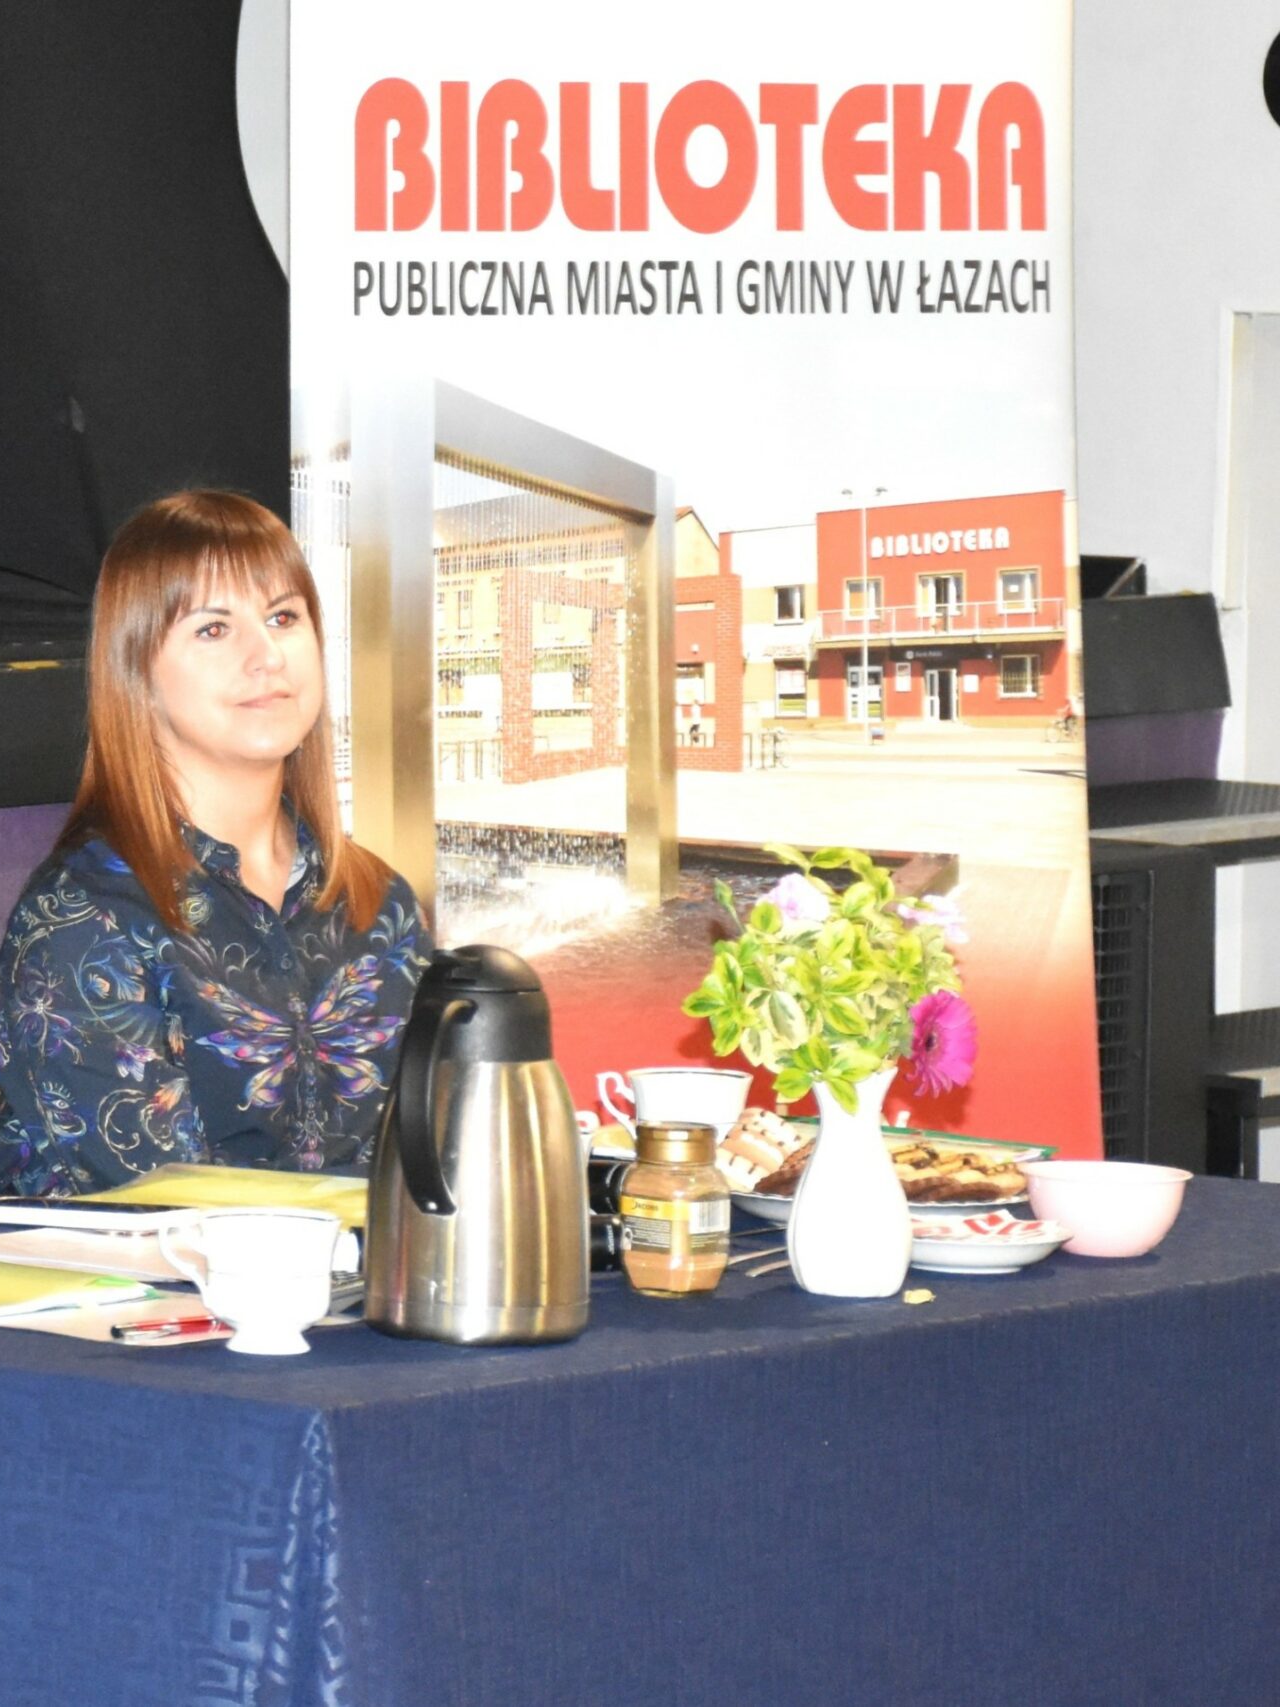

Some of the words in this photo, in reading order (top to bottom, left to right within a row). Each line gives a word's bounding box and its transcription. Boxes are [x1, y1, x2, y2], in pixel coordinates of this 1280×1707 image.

[354, 77, 1047, 233] BIBLIOTEKA
[353, 260, 554, 316] PUBLICZNA
[567, 260, 703, 315] MIASTA
[715, 260, 722, 314] I
[736, 259, 854, 314] GMINY
[866, 260, 904, 314] W
[916, 259, 1050, 314] ŁAZACH
[870, 526, 1010, 558] BIBLIOTEKA
